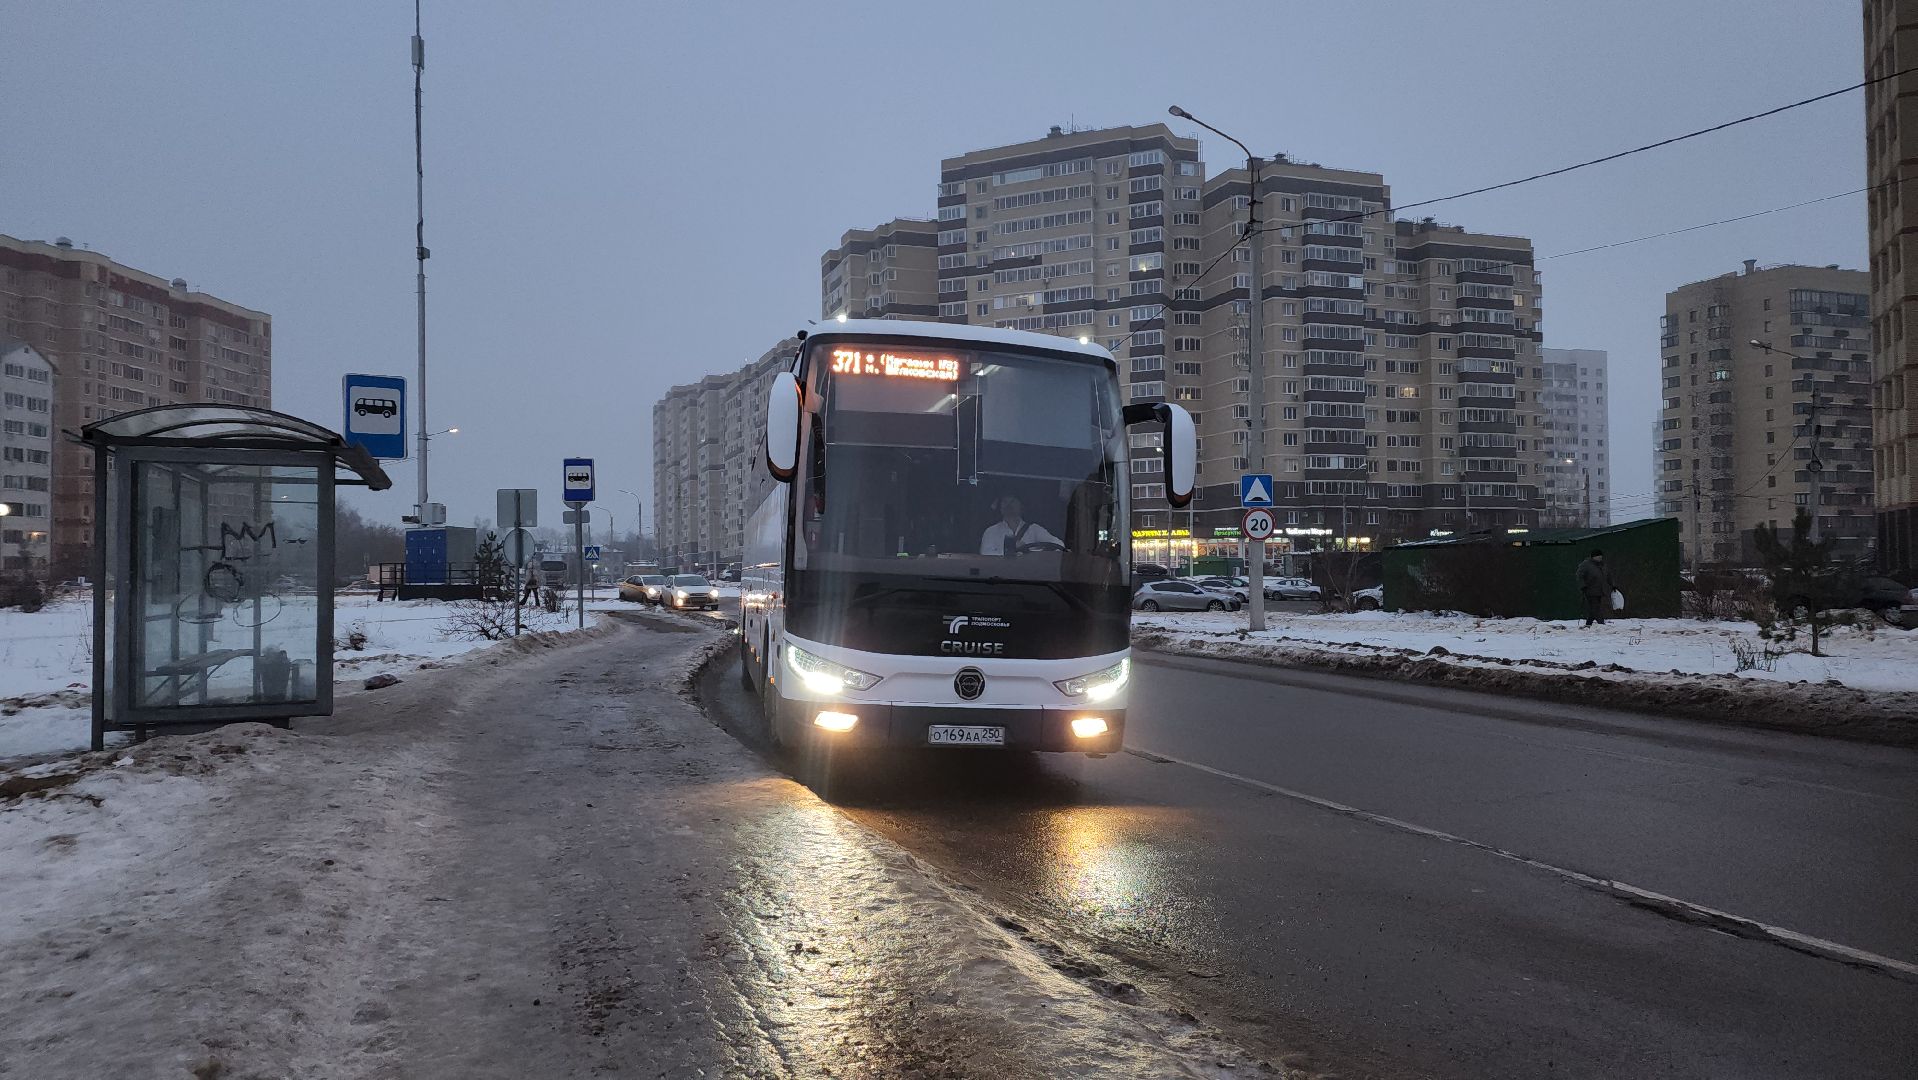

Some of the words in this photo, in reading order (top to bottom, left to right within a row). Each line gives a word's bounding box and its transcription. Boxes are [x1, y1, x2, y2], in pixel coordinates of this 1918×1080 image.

[832, 350, 861, 374] 371
[1250, 518, 1269, 532] 20
[940, 640, 1004, 655] CRUISE
